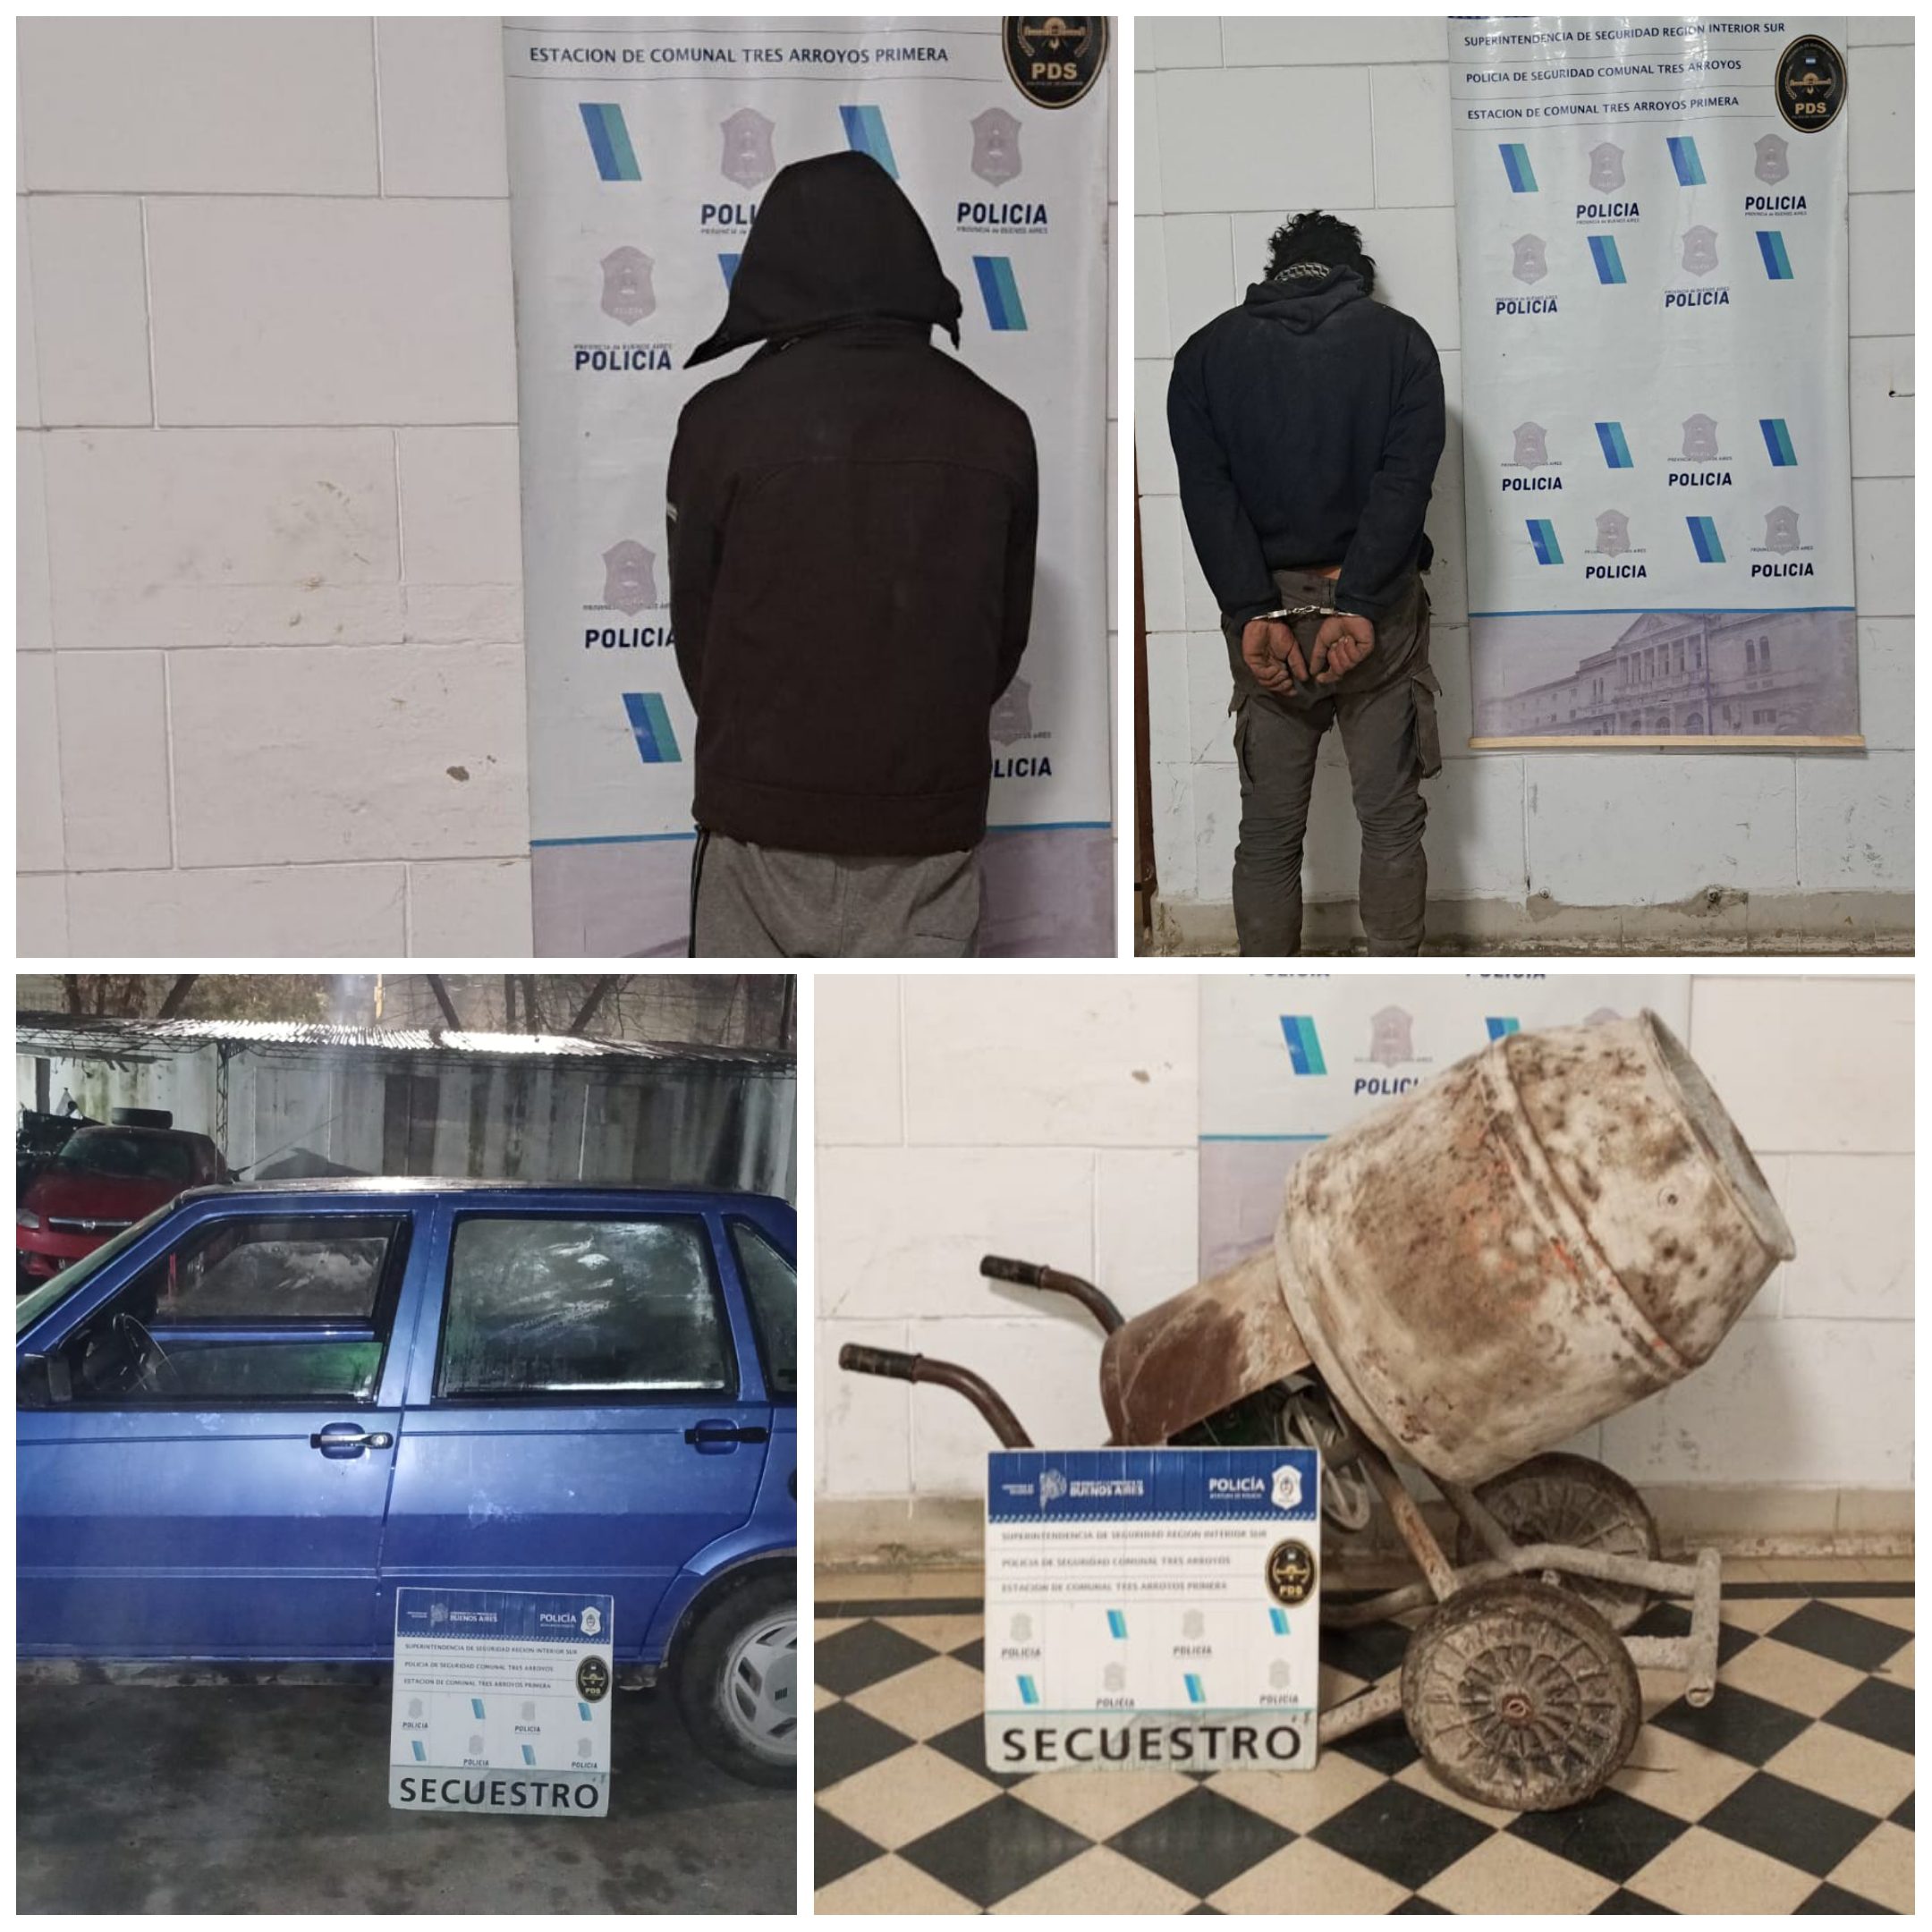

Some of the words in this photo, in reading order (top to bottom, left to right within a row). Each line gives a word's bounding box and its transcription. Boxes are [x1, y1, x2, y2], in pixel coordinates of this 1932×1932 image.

[1464, 31, 1572, 46] SUPERINTENDENCIA
[1577, 31, 1591, 41] DE
[1595, 28, 1659, 40] SEGURIDAD
[1663, 24, 1705, 38] REGION
[1709, 22, 1760, 33] INTERIOR
[1764, 22, 1785, 32] SUR
[529, 47, 616, 63] ESTACION
[622, 49, 645, 64] DE
[650, 48, 736, 63] COMUNAL
[741, 48, 784, 63] TRES
[788, 48, 870, 64] ARROYOS
[875, 47, 949, 62] PRIMERA
[1031, 62, 1078, 80] PDS
[1466, 72, 1510, 83] POLICIA
[1513, 72, 1528, 81] DE
[1530, 68, 1595, 81] SEGURIDAD
[1597, 64, 1654, 77] COMUNAL
[1657, 64, 1684, 73] TRES
[1688, 60, 1741, 72] ARROYOS
[1468, 108, 1522, 120] ESTACION
[1526, 107, 1541, 117] DE
[1544, 104, 1599, 116] COMUNAL
[1603, 102, 1630, 113] TRES
[1633, 100, 1687, 111] ARROYOS
[1690, 97, 1740, 108] PRIMERA
[1794, 102, 1826, 114] PDS
[1576, 202, 1640, 218] POLICIA
[1744, 195, 1808, 210] POLICIA
[701, 204, 756, 225] POLI
[957, 202, 1047, 225] POLICIA
[1496, 300, 1558, 315] POLICIA
[1665, 291, 1730, 308] POLICIA
[575, 350, 673, 371] POLICIA
[1502, 477, 1563, 492] POLICIA
[1668, 472, 1733, 487] POLICIA
[1585, 564, 1648, 579] POLICIA
[1751, 563, 1814, 578] POLICIA
[992, 757, 1053, 778] LICIA
[1354, 1078, 1419, 1095] POLIC
[539, 1613, 577, 1623] POLICÍA
[1002, 1725, 1301, 1762] SECUESTRO
[400, 1777, 599, 1809] SECUESTRO
